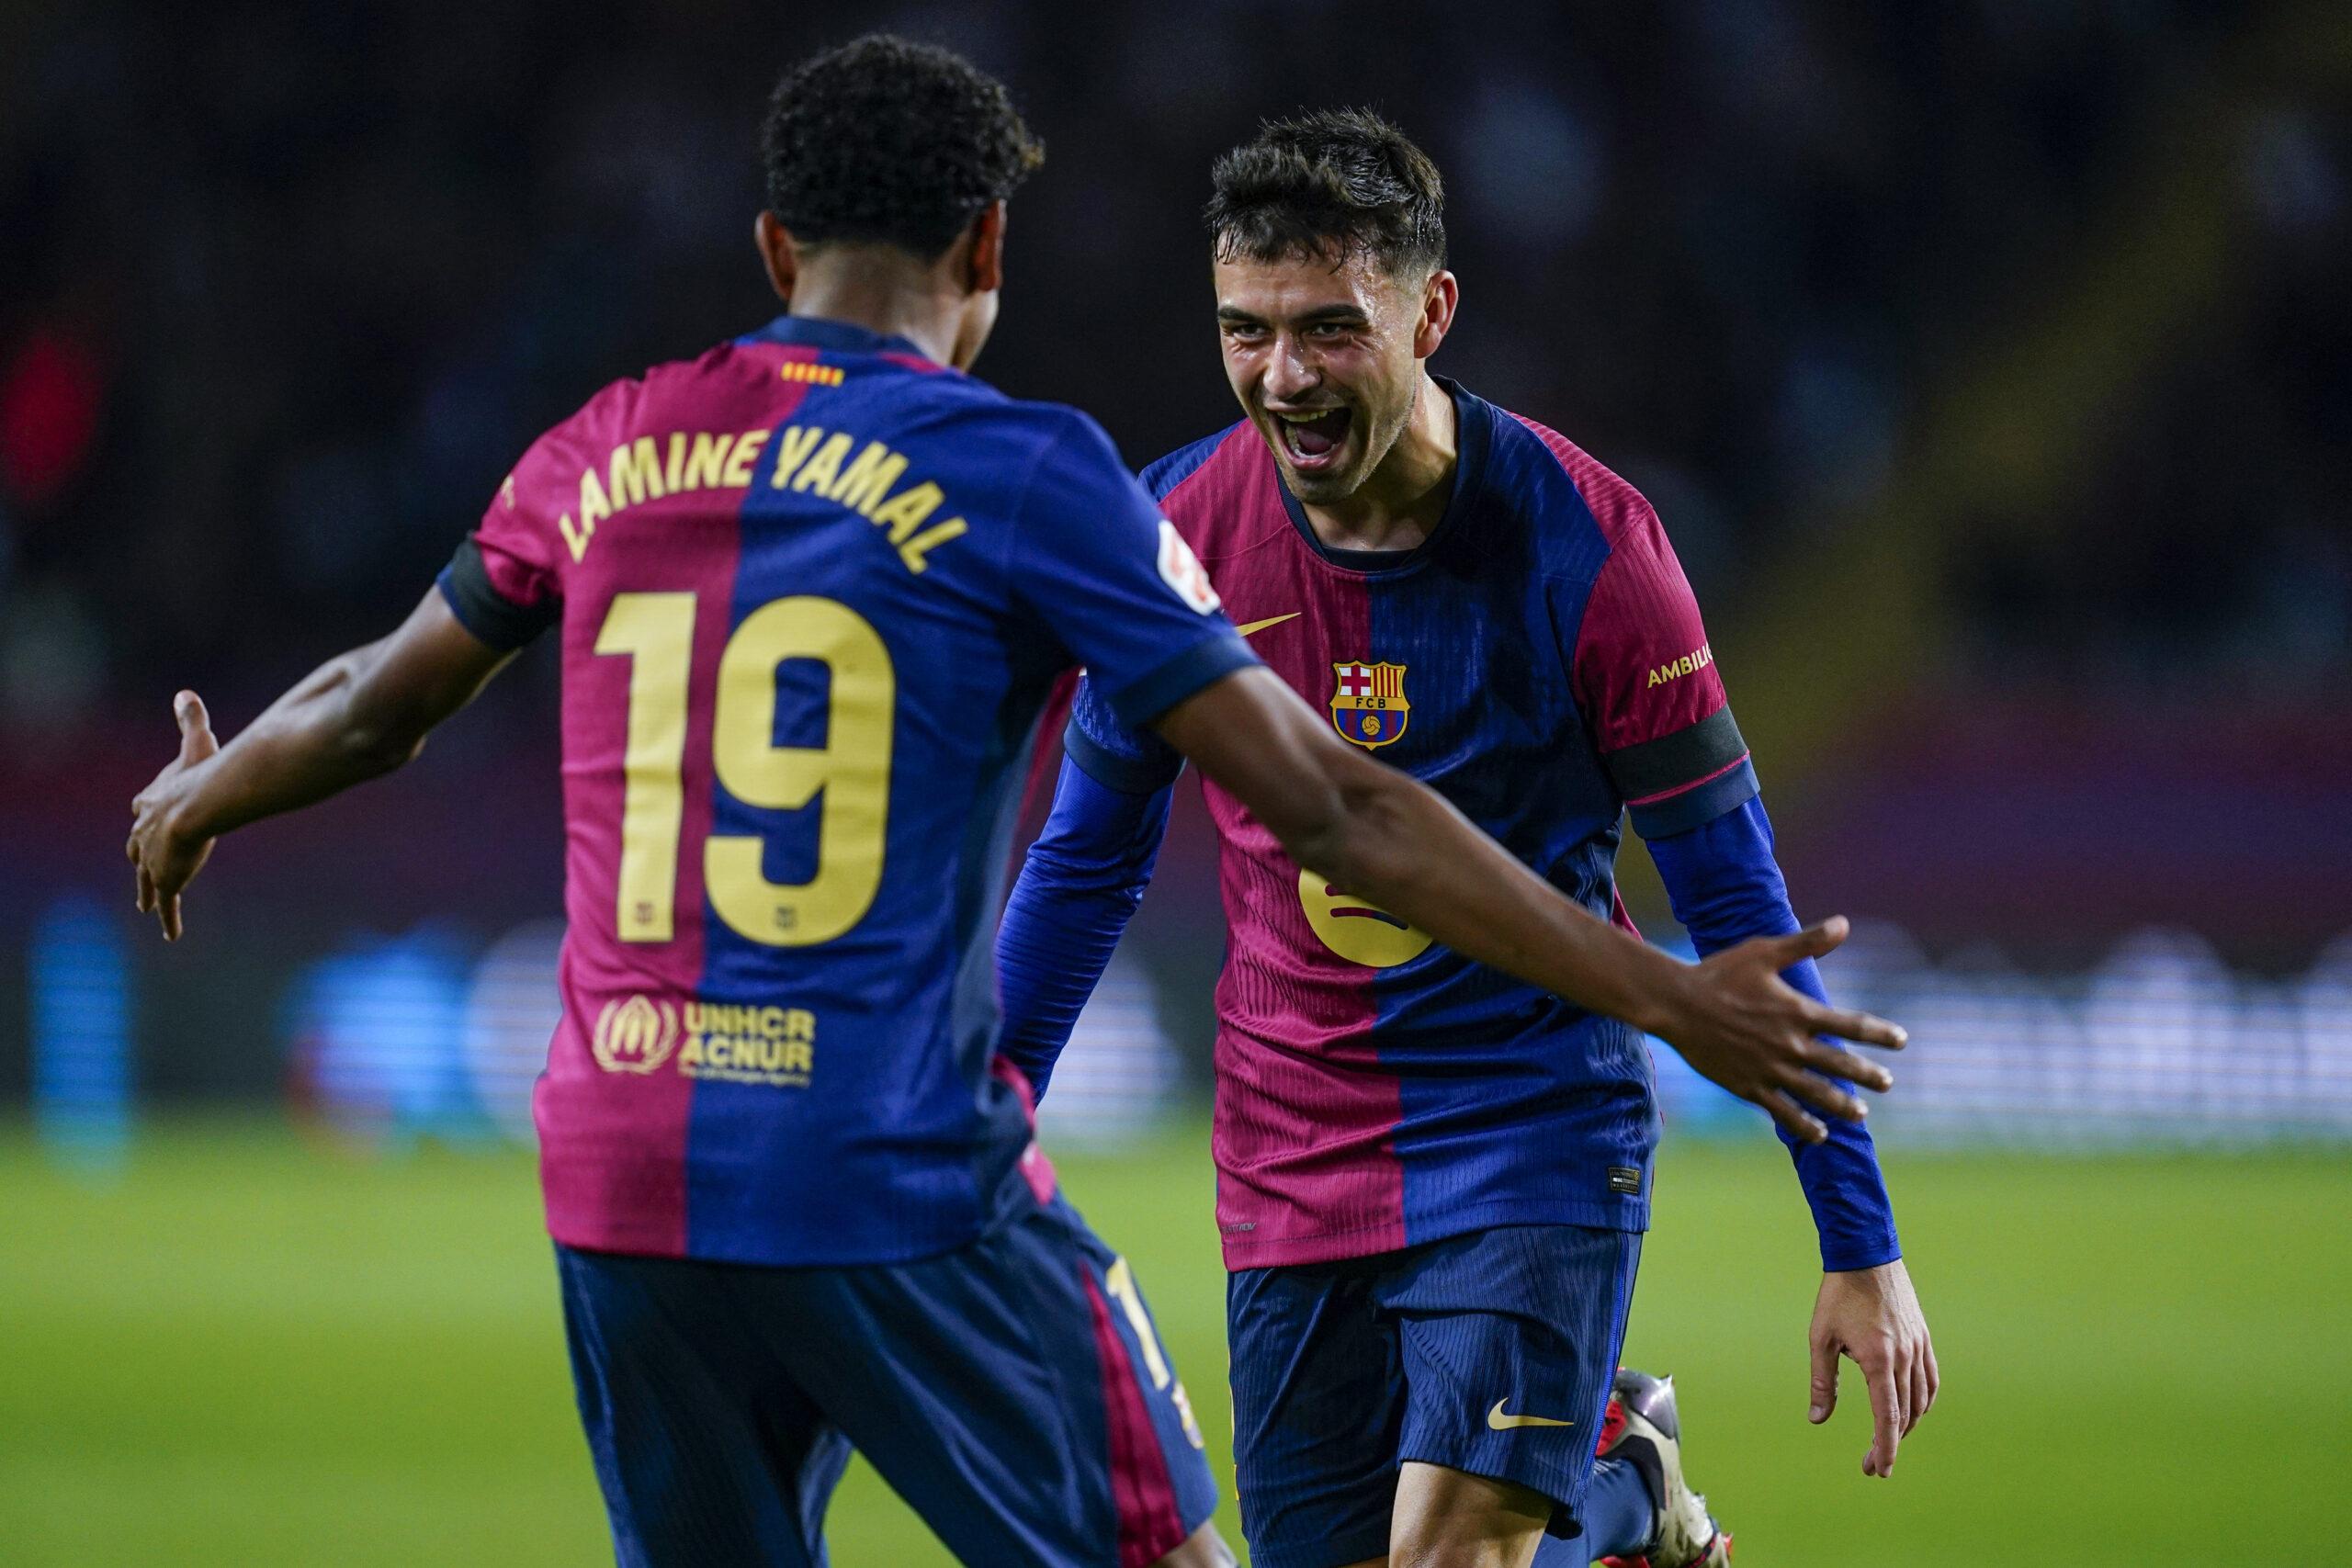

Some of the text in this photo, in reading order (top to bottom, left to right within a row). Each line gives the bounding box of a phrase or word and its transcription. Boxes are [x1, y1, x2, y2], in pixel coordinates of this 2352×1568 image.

[559, 425, 968, 574] LAMINE YAMAL
[594, 592, 896, 947] 19
[677, 1035, 813, 1072] ACNUR
[684, 1000, 816, 1042] UNHCR
